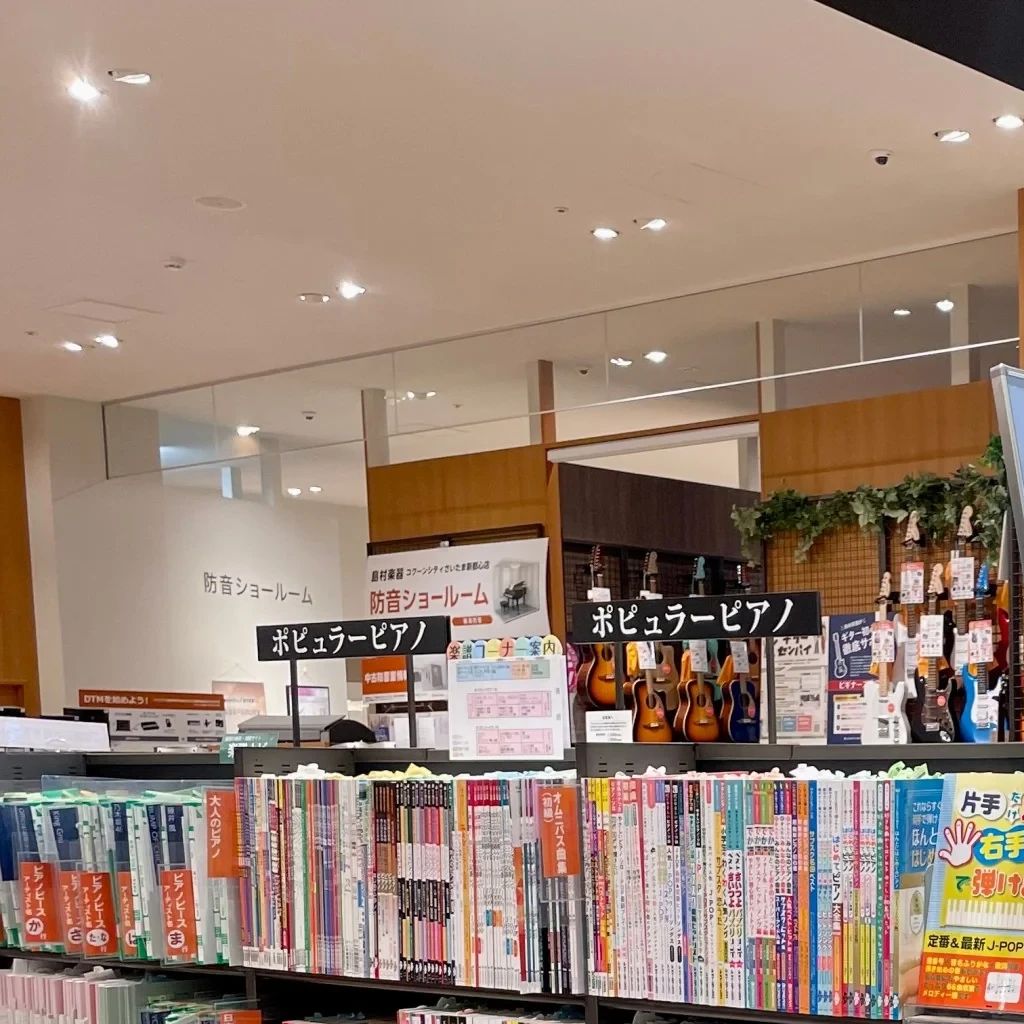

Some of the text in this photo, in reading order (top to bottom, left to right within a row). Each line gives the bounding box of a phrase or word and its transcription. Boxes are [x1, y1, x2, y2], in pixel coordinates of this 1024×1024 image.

[203, 571, 313, 605] 防音ショールーム
[371, 567, 404, 583] 島村楽器
[370, 582, 489, 616] 防音ショールーム
[591, 598, 794, 638] ポピュラーピアノ
[271, 620, 428, 658] ポピュラーピアノ
[208, 794, 223, 860] 大人のピアノ
[552, 791, 568, 876] オムニバス曲集
[33, 864, 47, 918] ピアノピース
[91, 874, 107, 929] ピアノピース
[173, 872, 188, 929] ピアノピース
[28, 919, 42, 931] か
[169, 931, 183, 947] ま
[927, 935, 986, 952] 定番&最新
